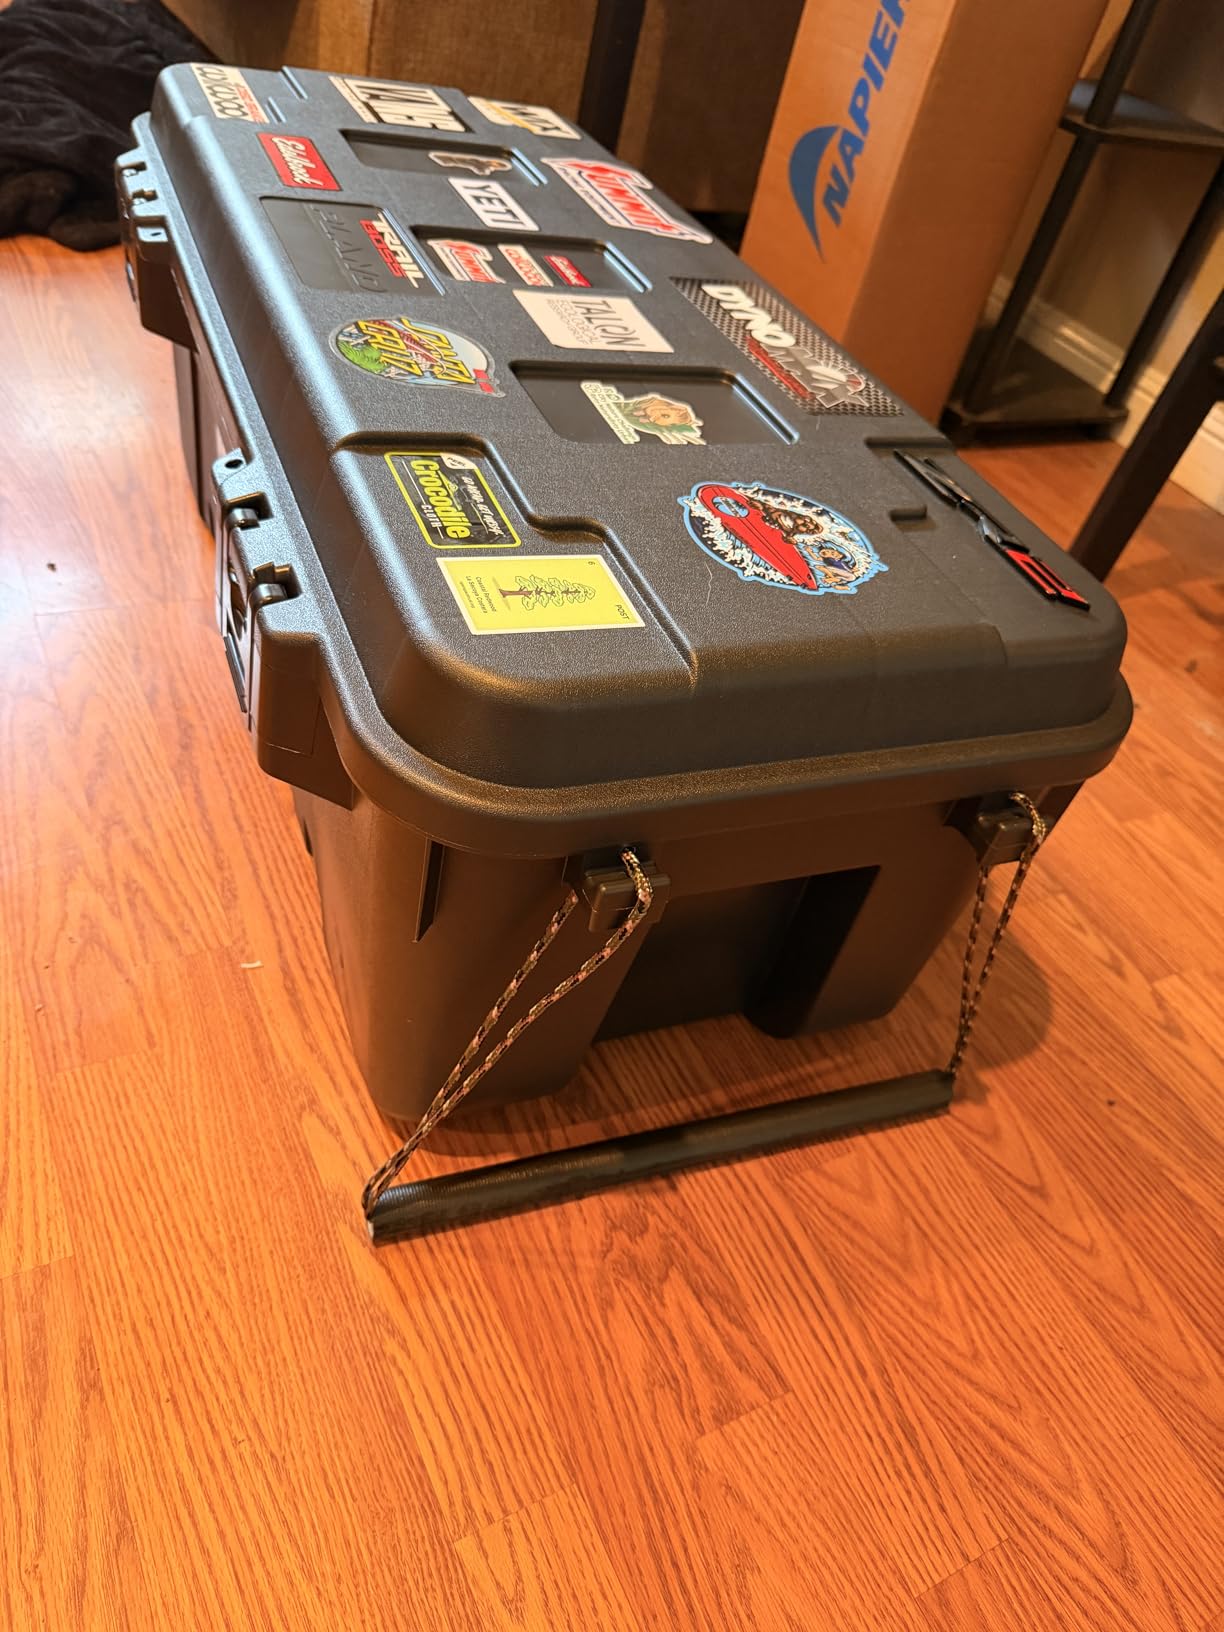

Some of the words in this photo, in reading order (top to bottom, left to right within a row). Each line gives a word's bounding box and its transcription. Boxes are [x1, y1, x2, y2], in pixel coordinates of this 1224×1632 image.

[461, 184, 525, 227] YETI
[359, 219, 406, 279] BOSS
[372, 211, 425, 289] TRAIL
[571, 300, 646, 348] TALON
[701, 284, 796, 348] DYNO
[410, 460, 472, 539] Crocodile
[421, 504, 443, 528] CLOTH
[616, 604, 631, 620] POST
